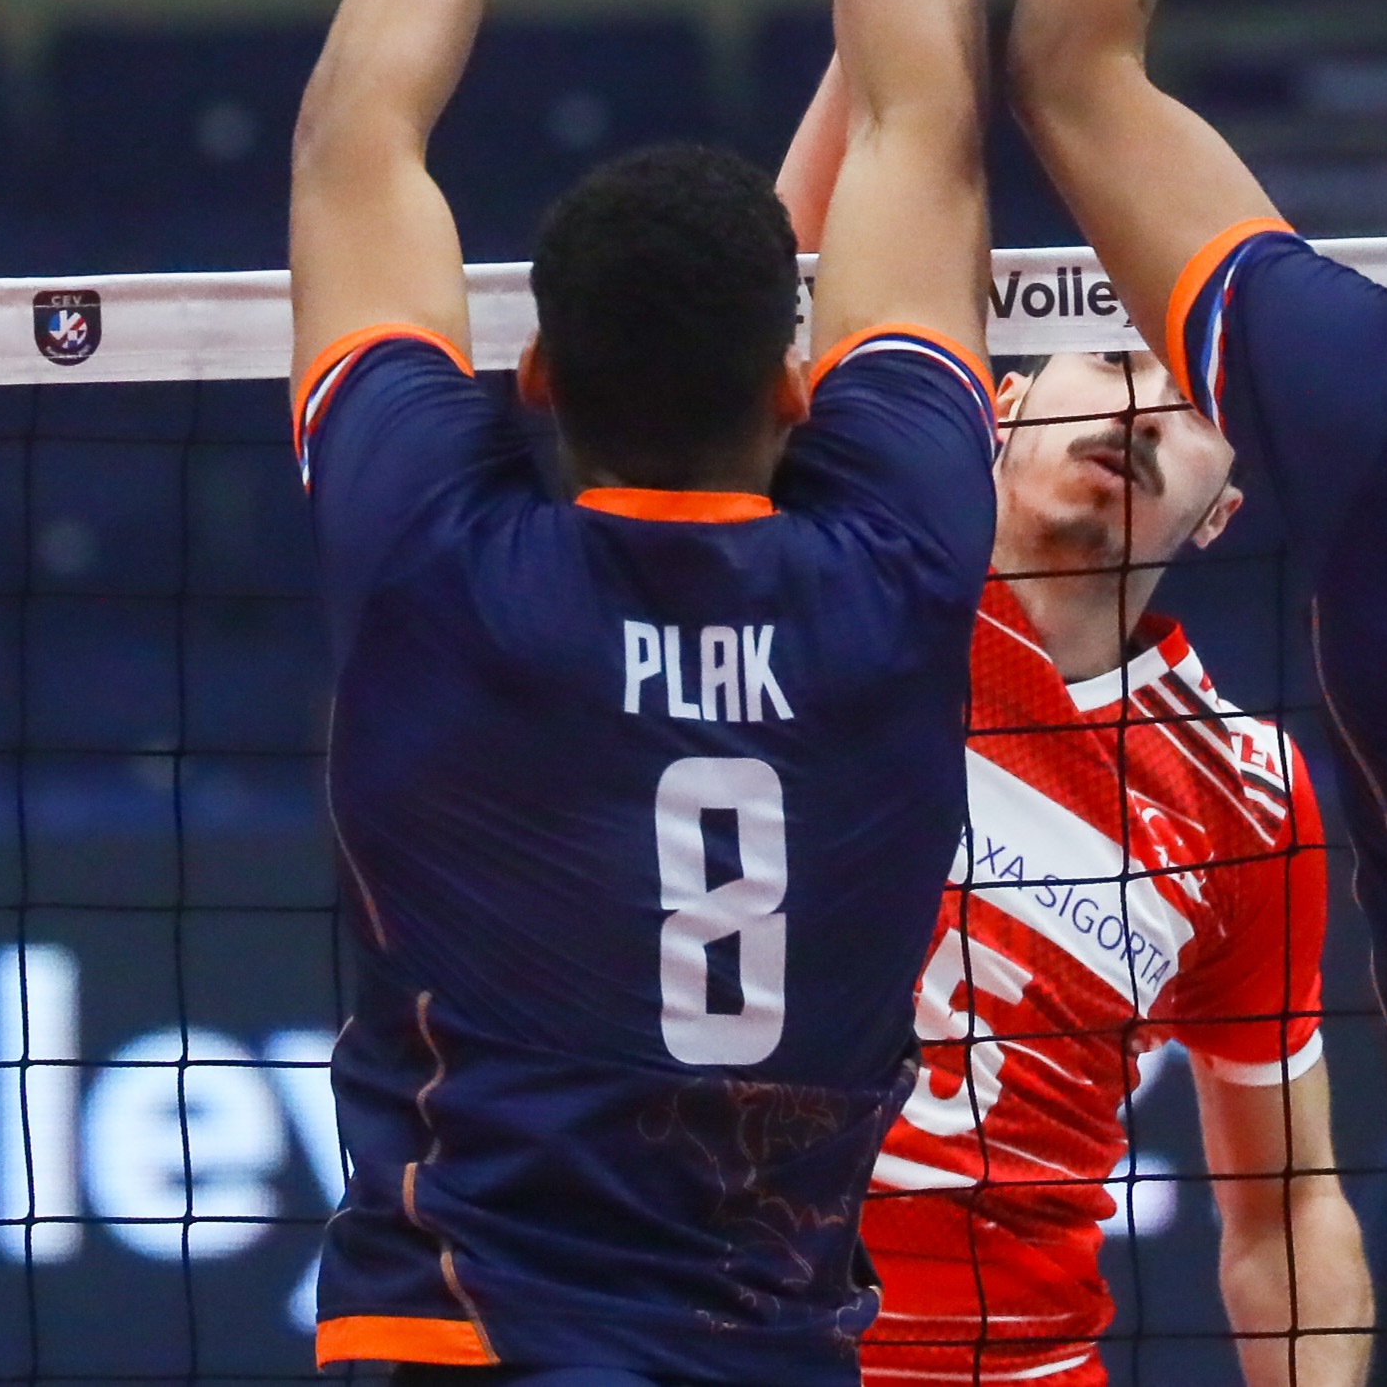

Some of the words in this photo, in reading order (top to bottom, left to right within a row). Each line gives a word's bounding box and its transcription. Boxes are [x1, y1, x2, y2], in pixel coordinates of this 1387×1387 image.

[989, 267, 1134, 327] Volle
[624, 620, 794, 722] PLAK
[655, 757, 787, 1065] 8
[959, 832, 1024, 890] XA
[1035, 874, 1171, 992] SIGORTA
